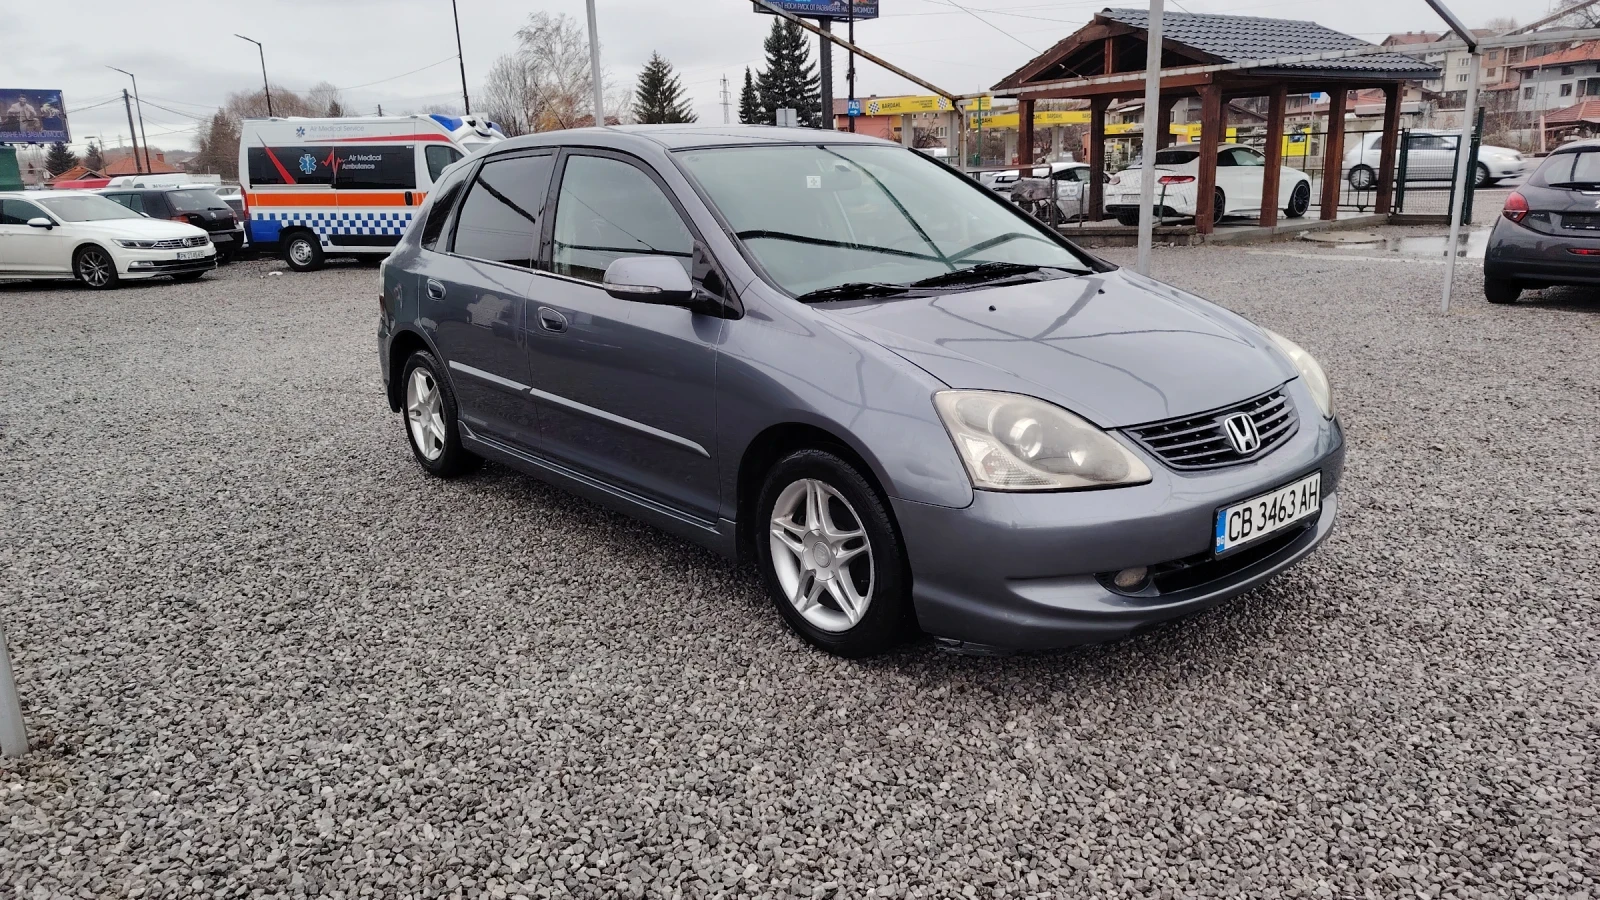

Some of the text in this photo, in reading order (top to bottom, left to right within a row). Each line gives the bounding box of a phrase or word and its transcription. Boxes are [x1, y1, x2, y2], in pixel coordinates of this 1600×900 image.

[848, 101, 859, 109] ГАЗ
[972, 117, 993, 125] BADAHL
[1228, 478, 1318, 542] CB 3463 AH
[1216, 535, 1225, 547] BG
